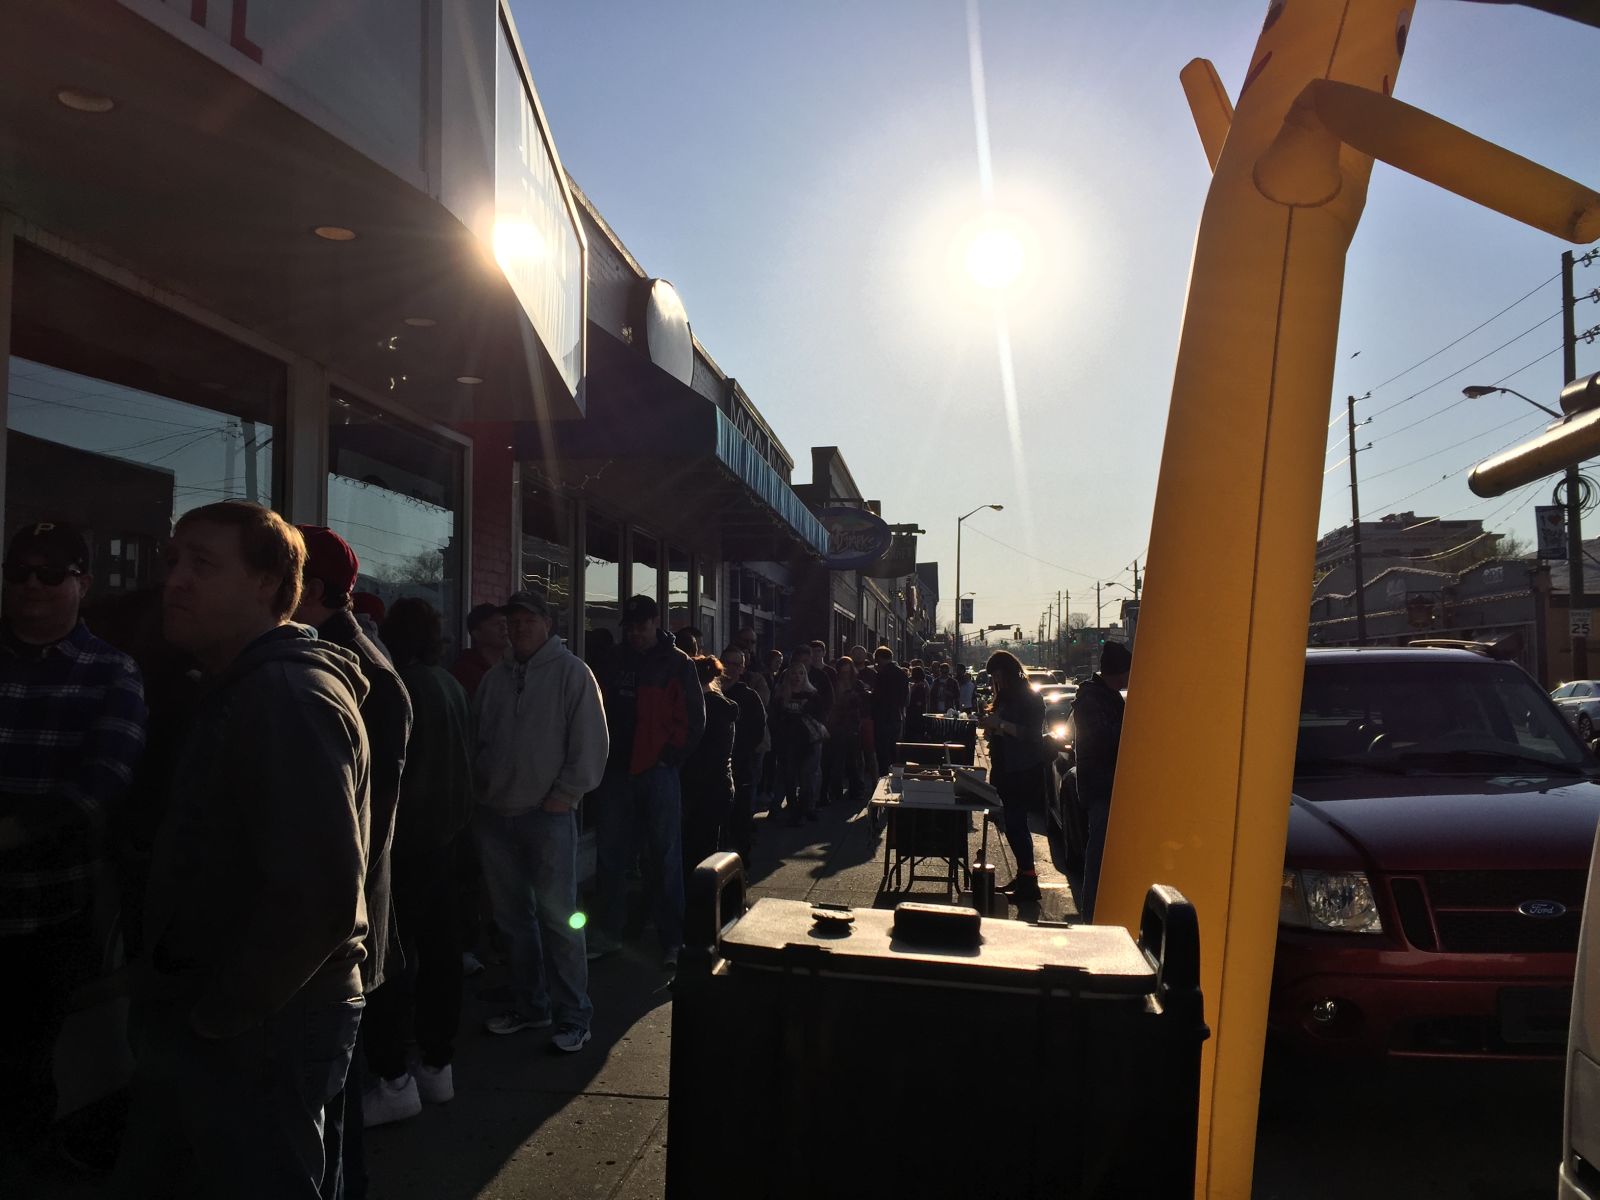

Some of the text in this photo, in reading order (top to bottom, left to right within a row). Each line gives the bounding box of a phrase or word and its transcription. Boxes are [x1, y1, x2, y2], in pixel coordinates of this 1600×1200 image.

[33, 522, 56, 536] P
[1571, 623, 1591, 634] 25
[1529, 903, 1555, 914] Ford
